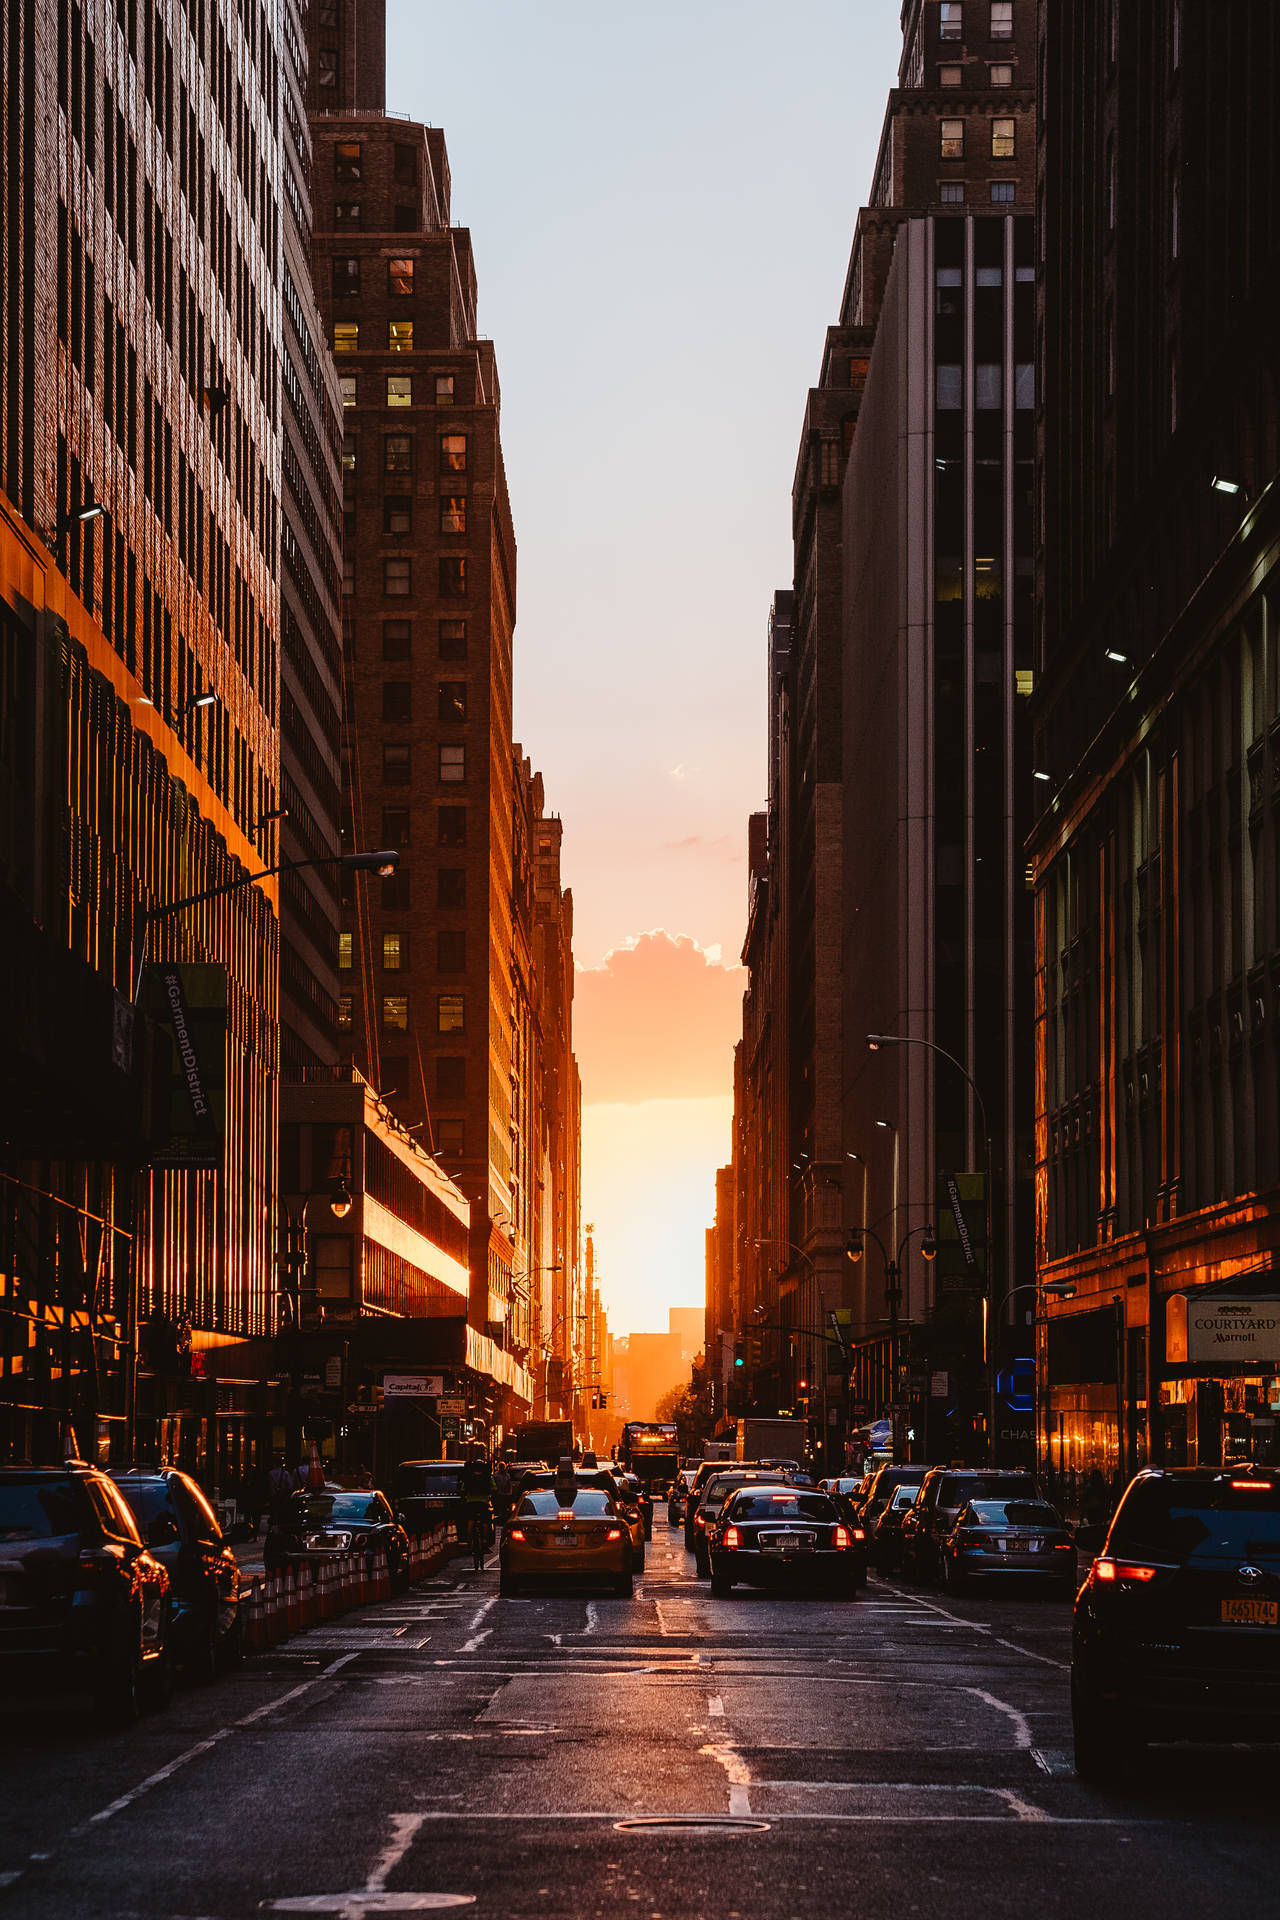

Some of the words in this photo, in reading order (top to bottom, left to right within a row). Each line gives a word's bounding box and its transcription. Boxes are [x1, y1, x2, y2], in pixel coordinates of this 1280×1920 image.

[165, 975, 208, 1116] #GarmentDistrict
[1195, 1319, 1276, 1329] COURTYARD
[1213, 1333, 1255, 1343] Marriott
[389, 1383, 420, 1392] Capital
[1001, 1430, 1037, 1440] CHAS
